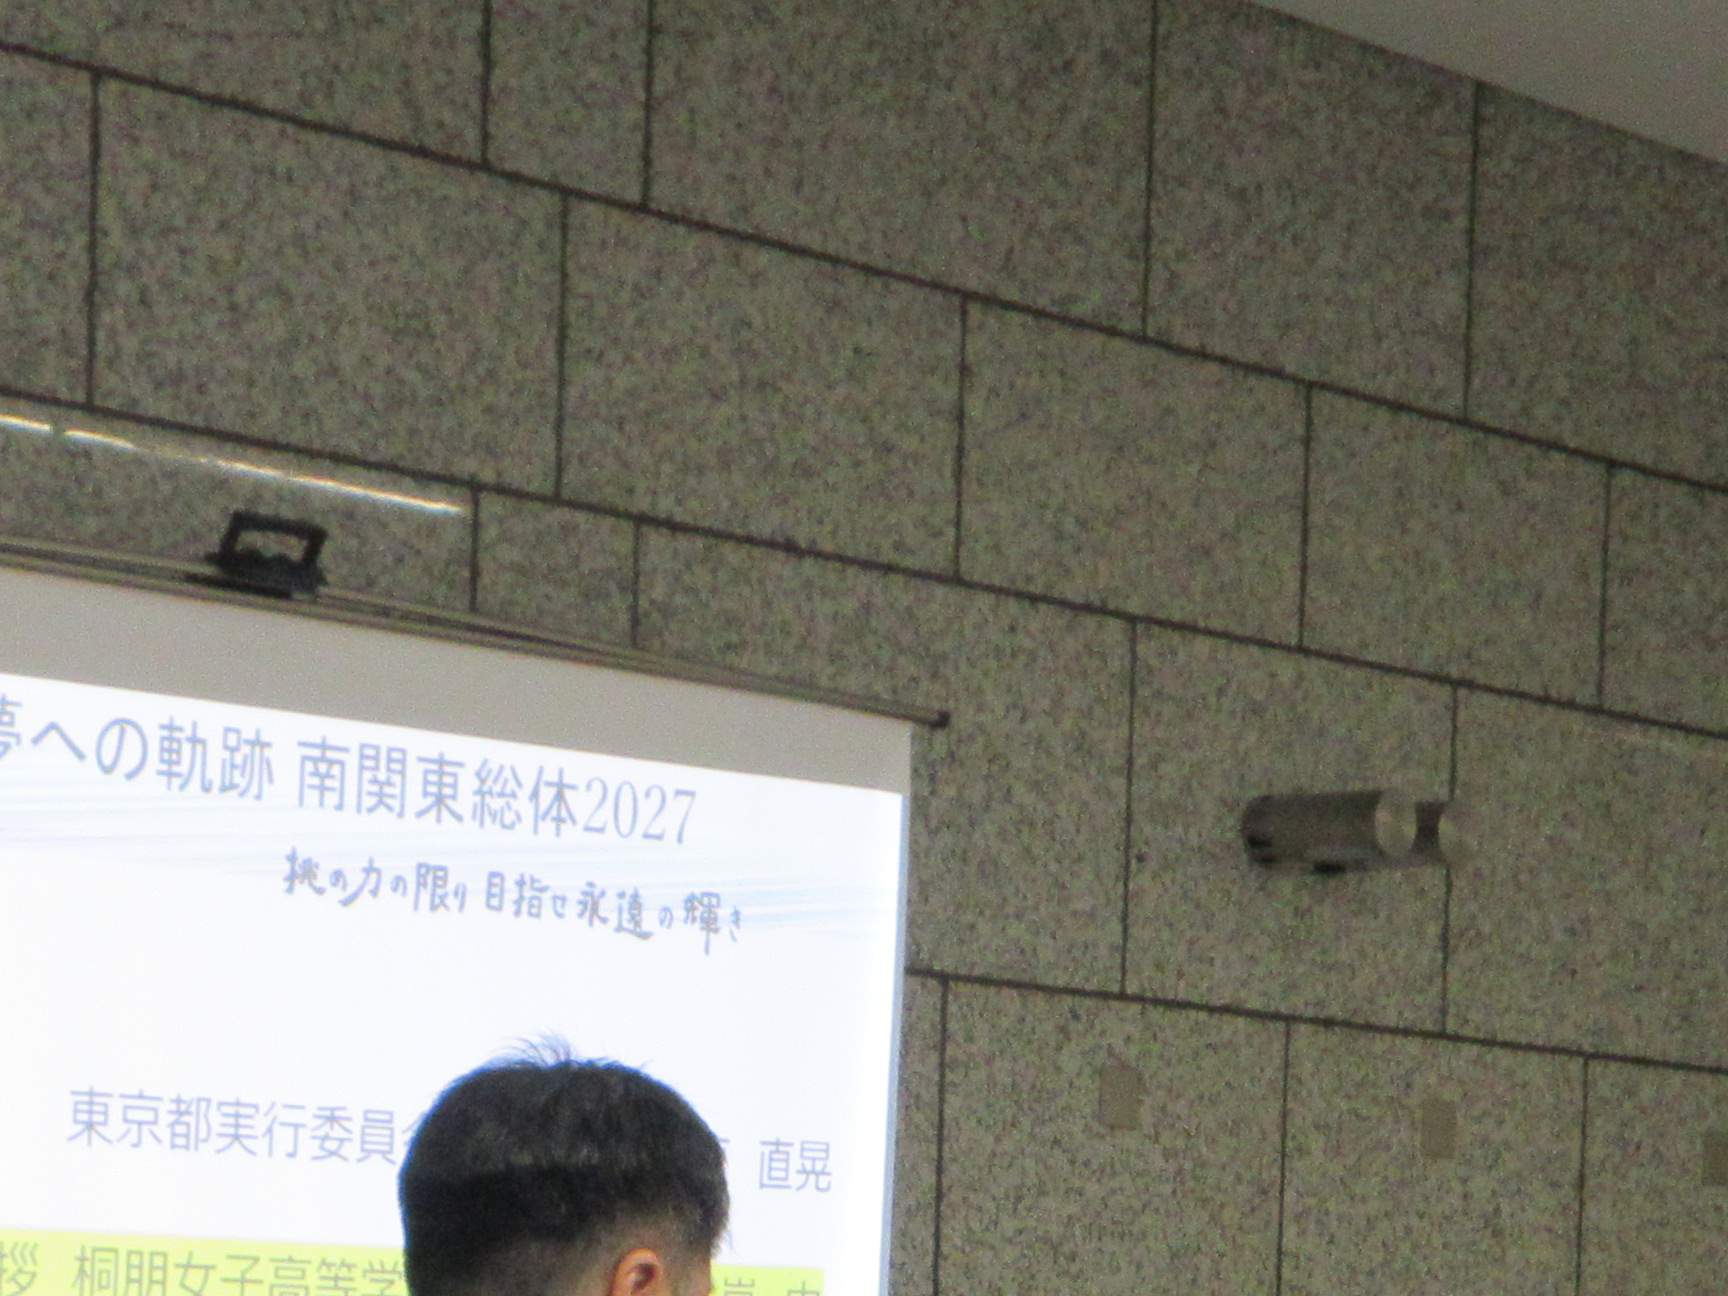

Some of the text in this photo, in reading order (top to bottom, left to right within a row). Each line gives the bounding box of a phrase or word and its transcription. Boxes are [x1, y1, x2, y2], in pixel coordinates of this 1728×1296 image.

[296, 735, 698, 846] 南関東総体2027
[66, 1086, 425, 1166] 東京都実行委員
[759, 1137, 832, 1192] 直晃
